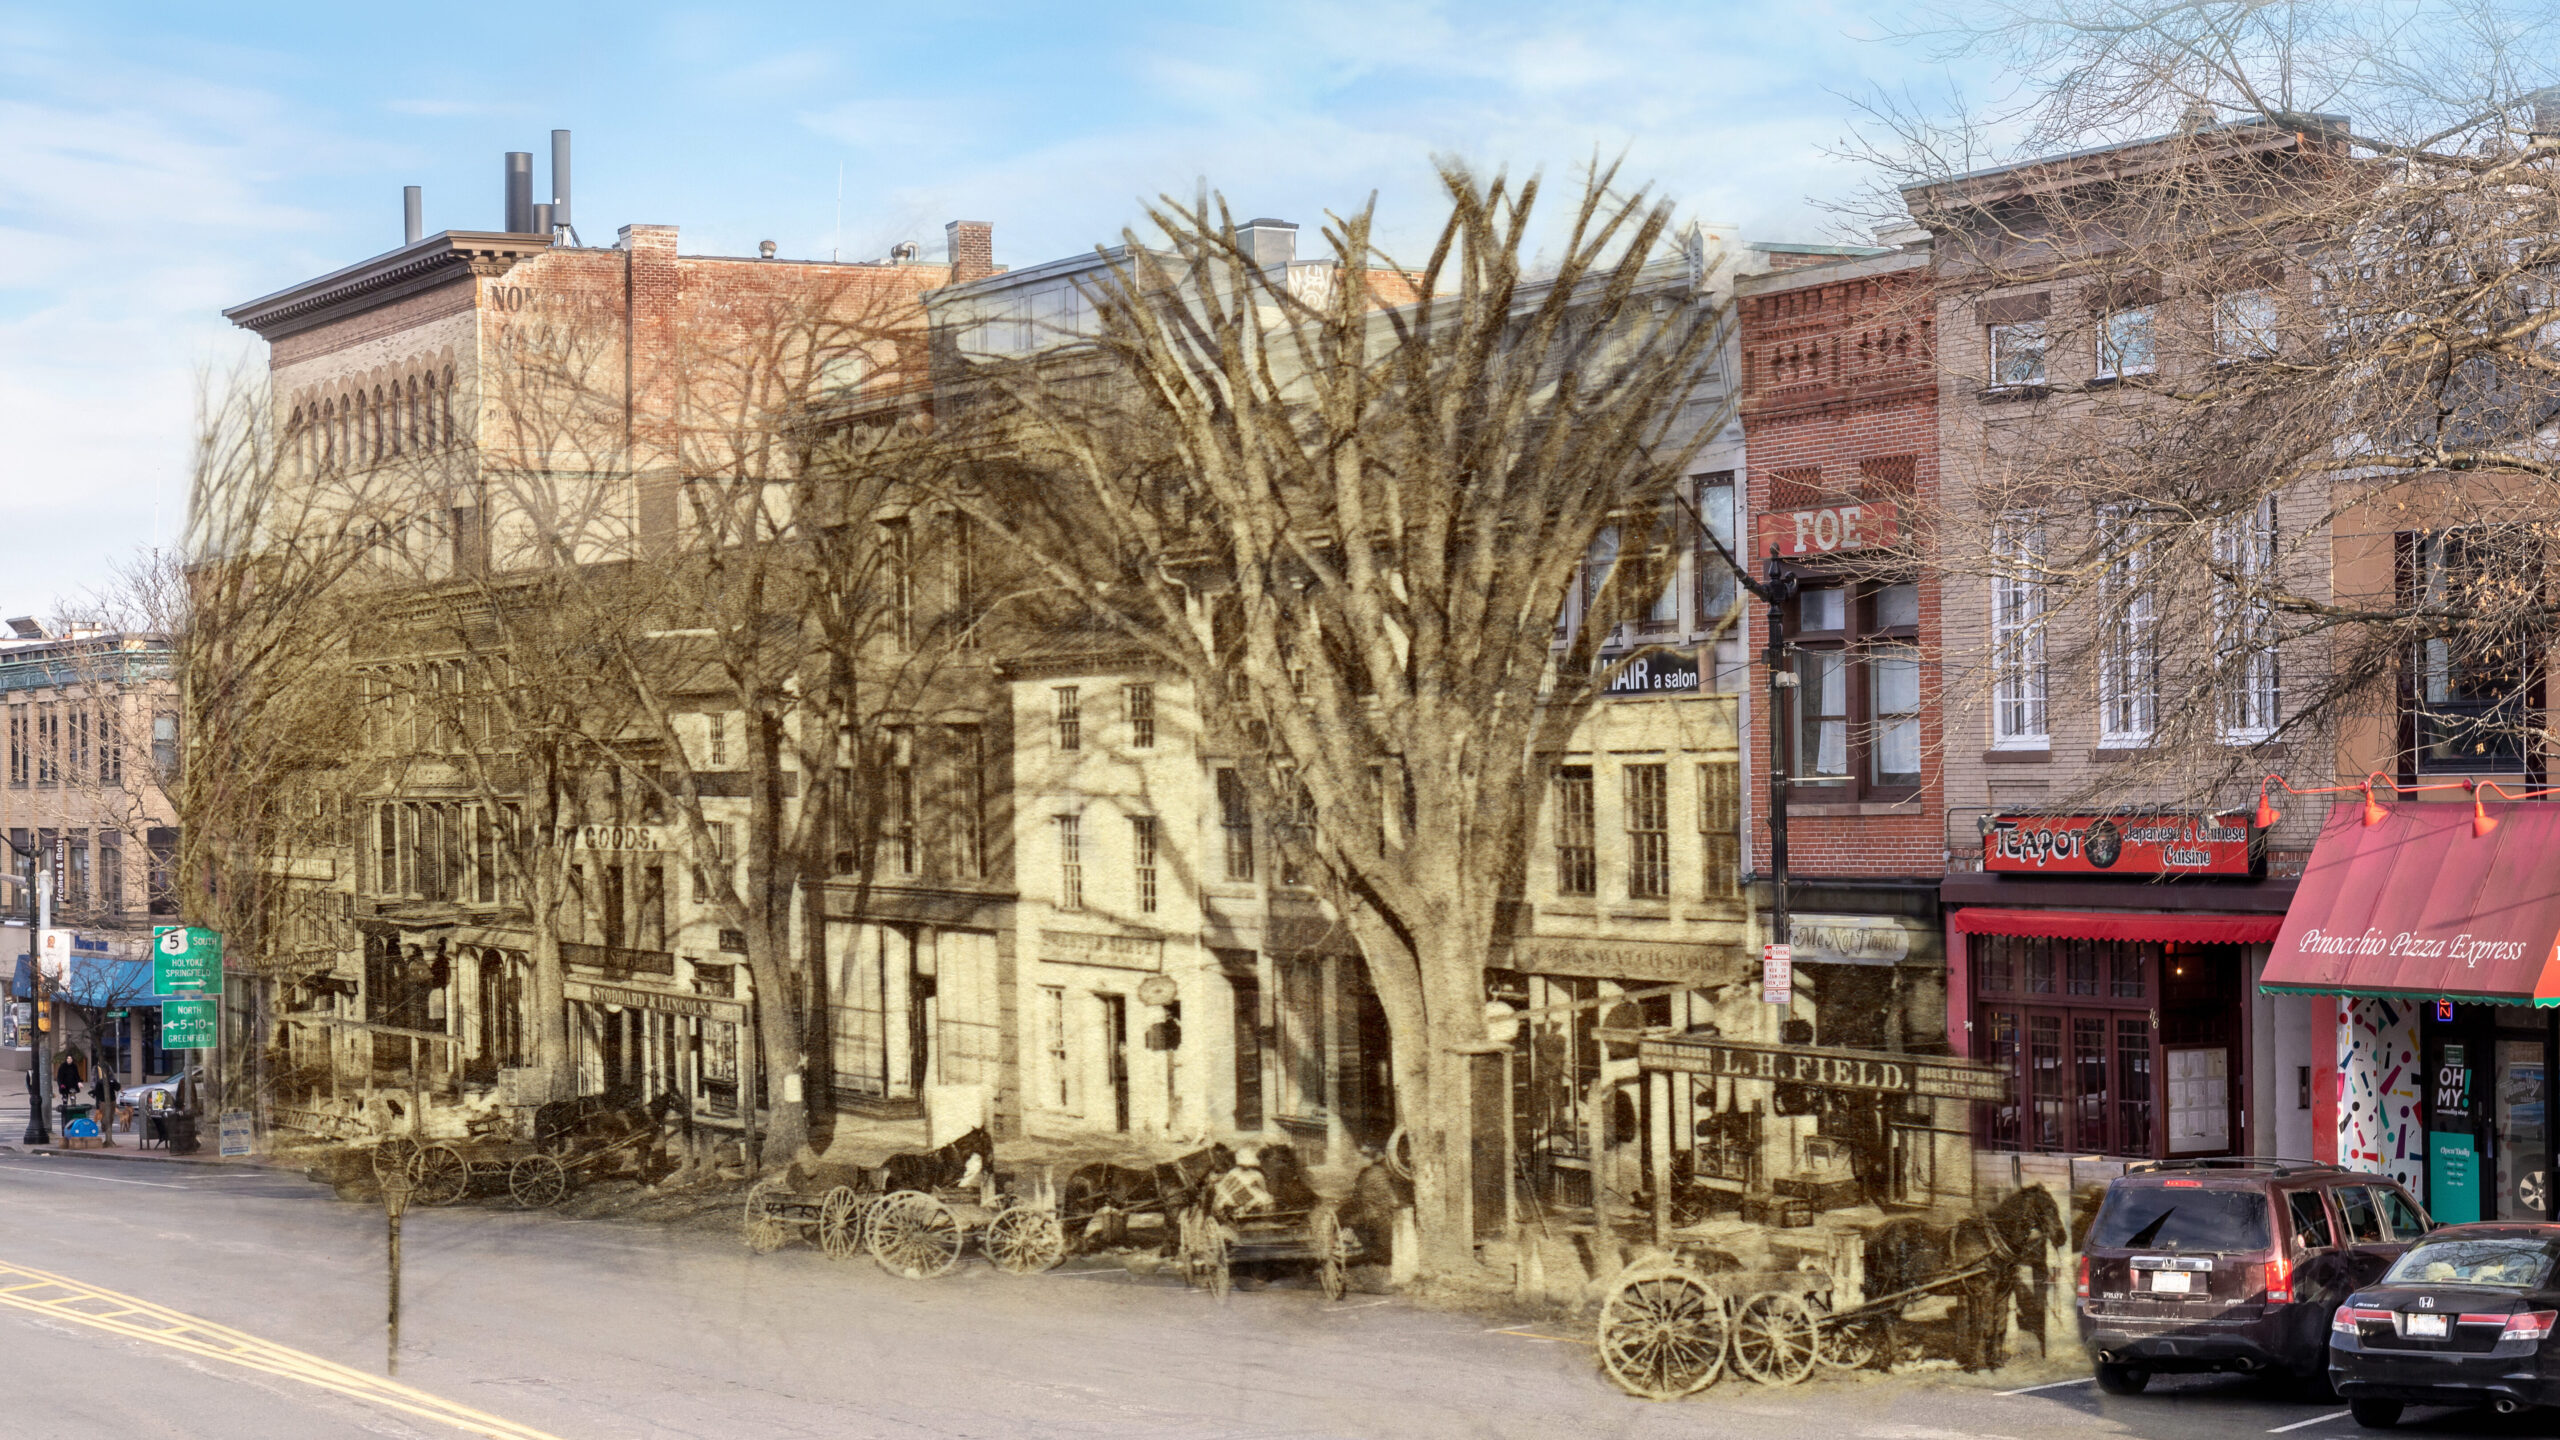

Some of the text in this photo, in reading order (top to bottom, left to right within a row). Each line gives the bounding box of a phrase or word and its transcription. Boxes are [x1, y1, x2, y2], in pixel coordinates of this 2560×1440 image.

[1793, 506, 1862, 552] FOE
[1603, 658, 1697, 691] HAIR a salon
[2123, 823, 2181, 846] Japanese
[2184, 827, 2193, 842] &
[2163, 844, 2212, 866] Cuisine
[169, 935, 179, 949] 5
[1825, 926, 1857, 955] Not
[1856, 926, 1899, 955] Florist
[2299, 927, 2388, 956] Pinocchio
[2389, 930, 2448, 959] Pizza
[2447, 933, 2527, 968] Express
[165, 968, 211, 978] SPRINGFIELD
[171, 959, 204, 968] HOLYOKE
[592, 985, 646, 1007] STODDARD
[648, 993, 657, 1009] &
[177, 1005, 202, 1015] NORTH
[168, 1033, 212, 1043] GREENFIELD
[2439, 1067, 2465, 1087] OH
